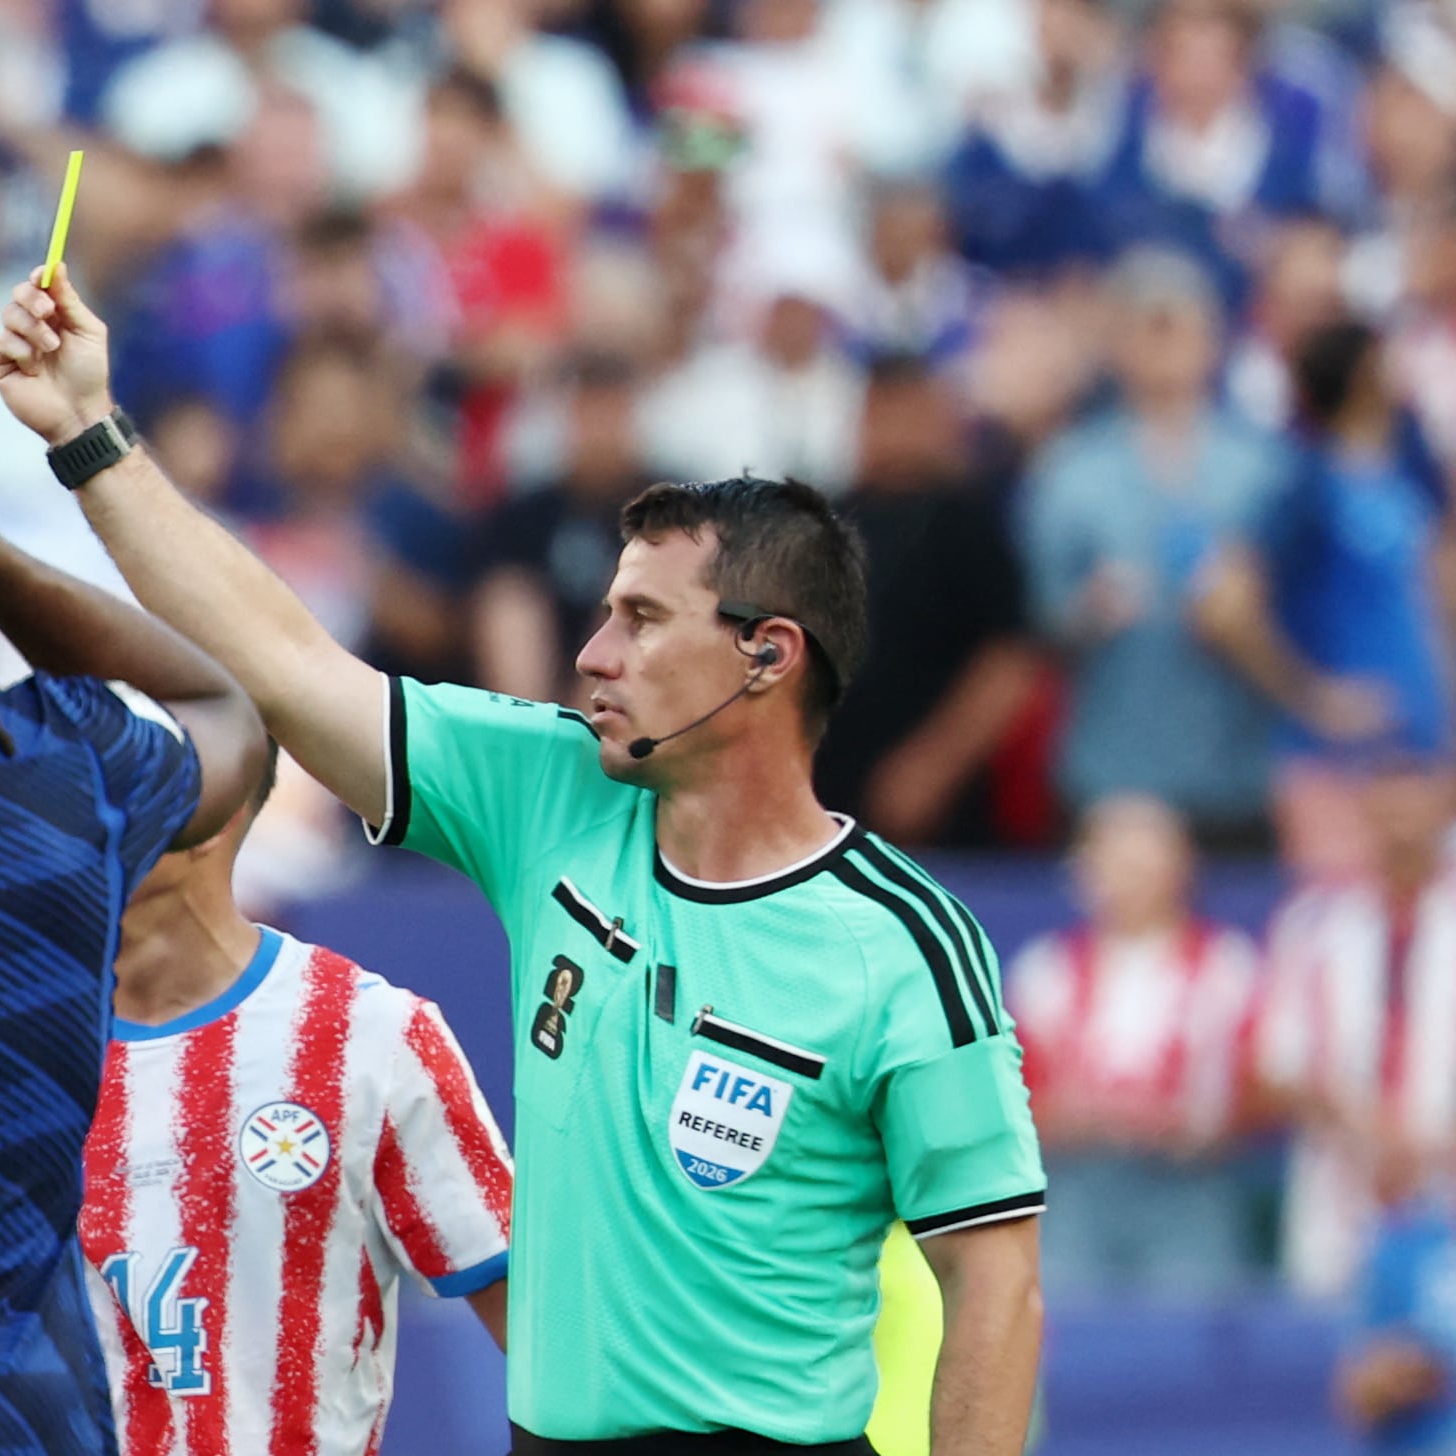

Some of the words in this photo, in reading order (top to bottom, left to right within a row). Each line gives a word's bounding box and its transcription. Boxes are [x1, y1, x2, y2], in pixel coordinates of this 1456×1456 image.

[691, 1062, 773, 1118] FIFA
[271, 1108, 301, 1124] APF
[678, 1110, 764, 1152] REFEREE
[686, 1158, 729, 1184] 2026
[100, 1246, 212, 1395] 14
